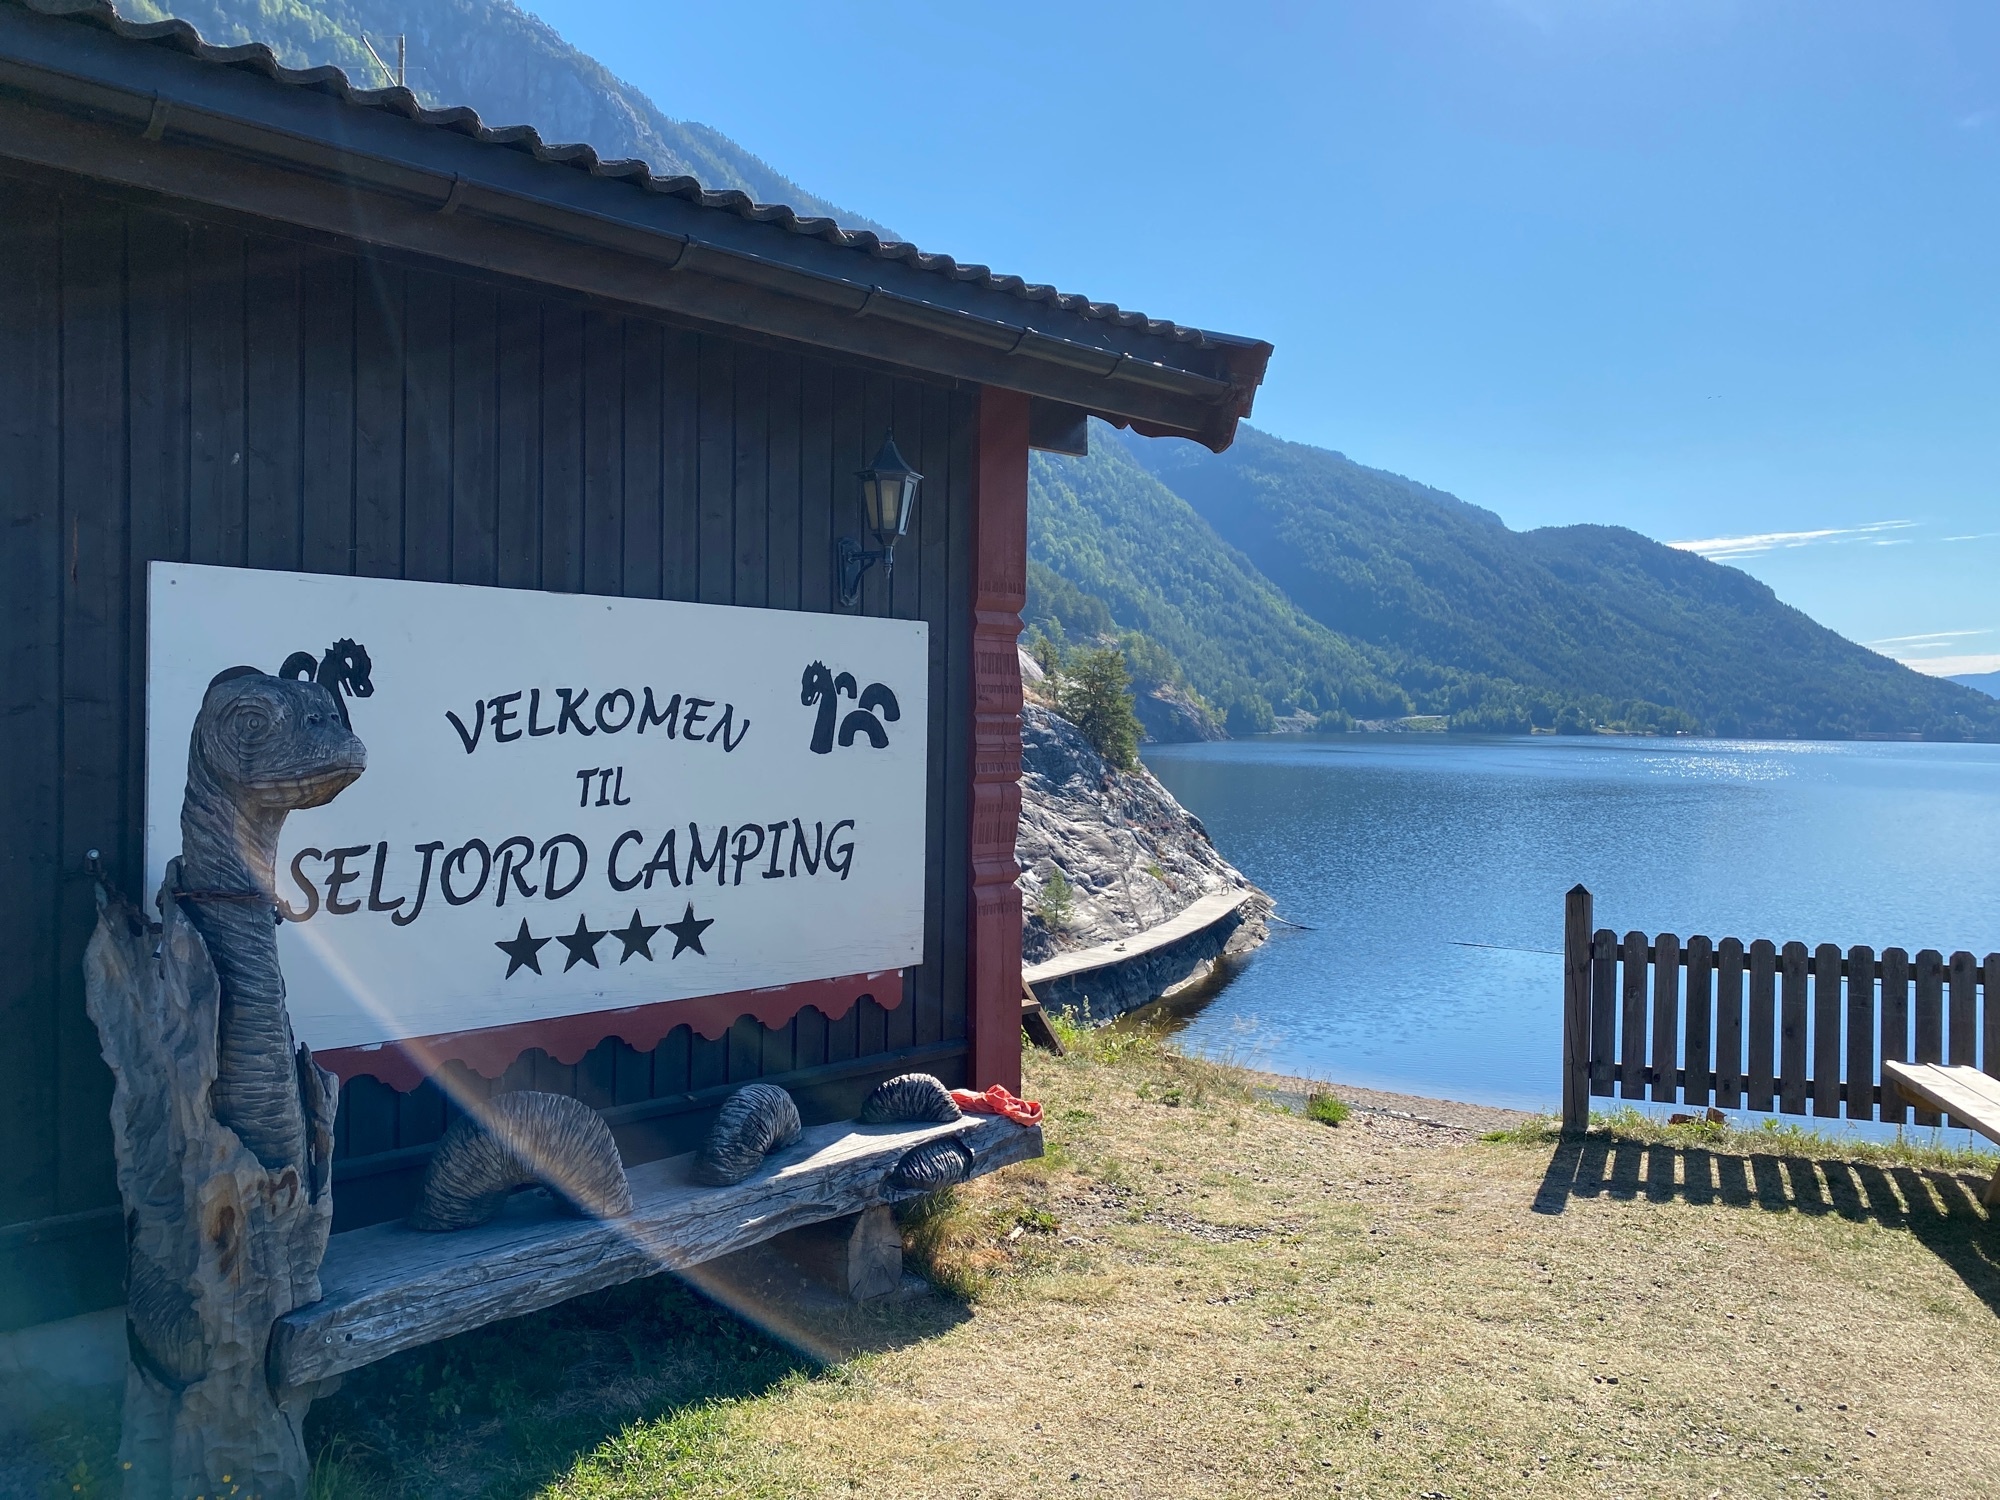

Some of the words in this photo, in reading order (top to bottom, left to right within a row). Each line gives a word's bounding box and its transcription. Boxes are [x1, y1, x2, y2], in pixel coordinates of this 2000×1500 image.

[445, 687, 750, 754] VELKOMEN
[577, 767, 631, 808] TIL
[281, 834, 588, 927] SELJORD
[608, 818, 855, 892] CAMPING
